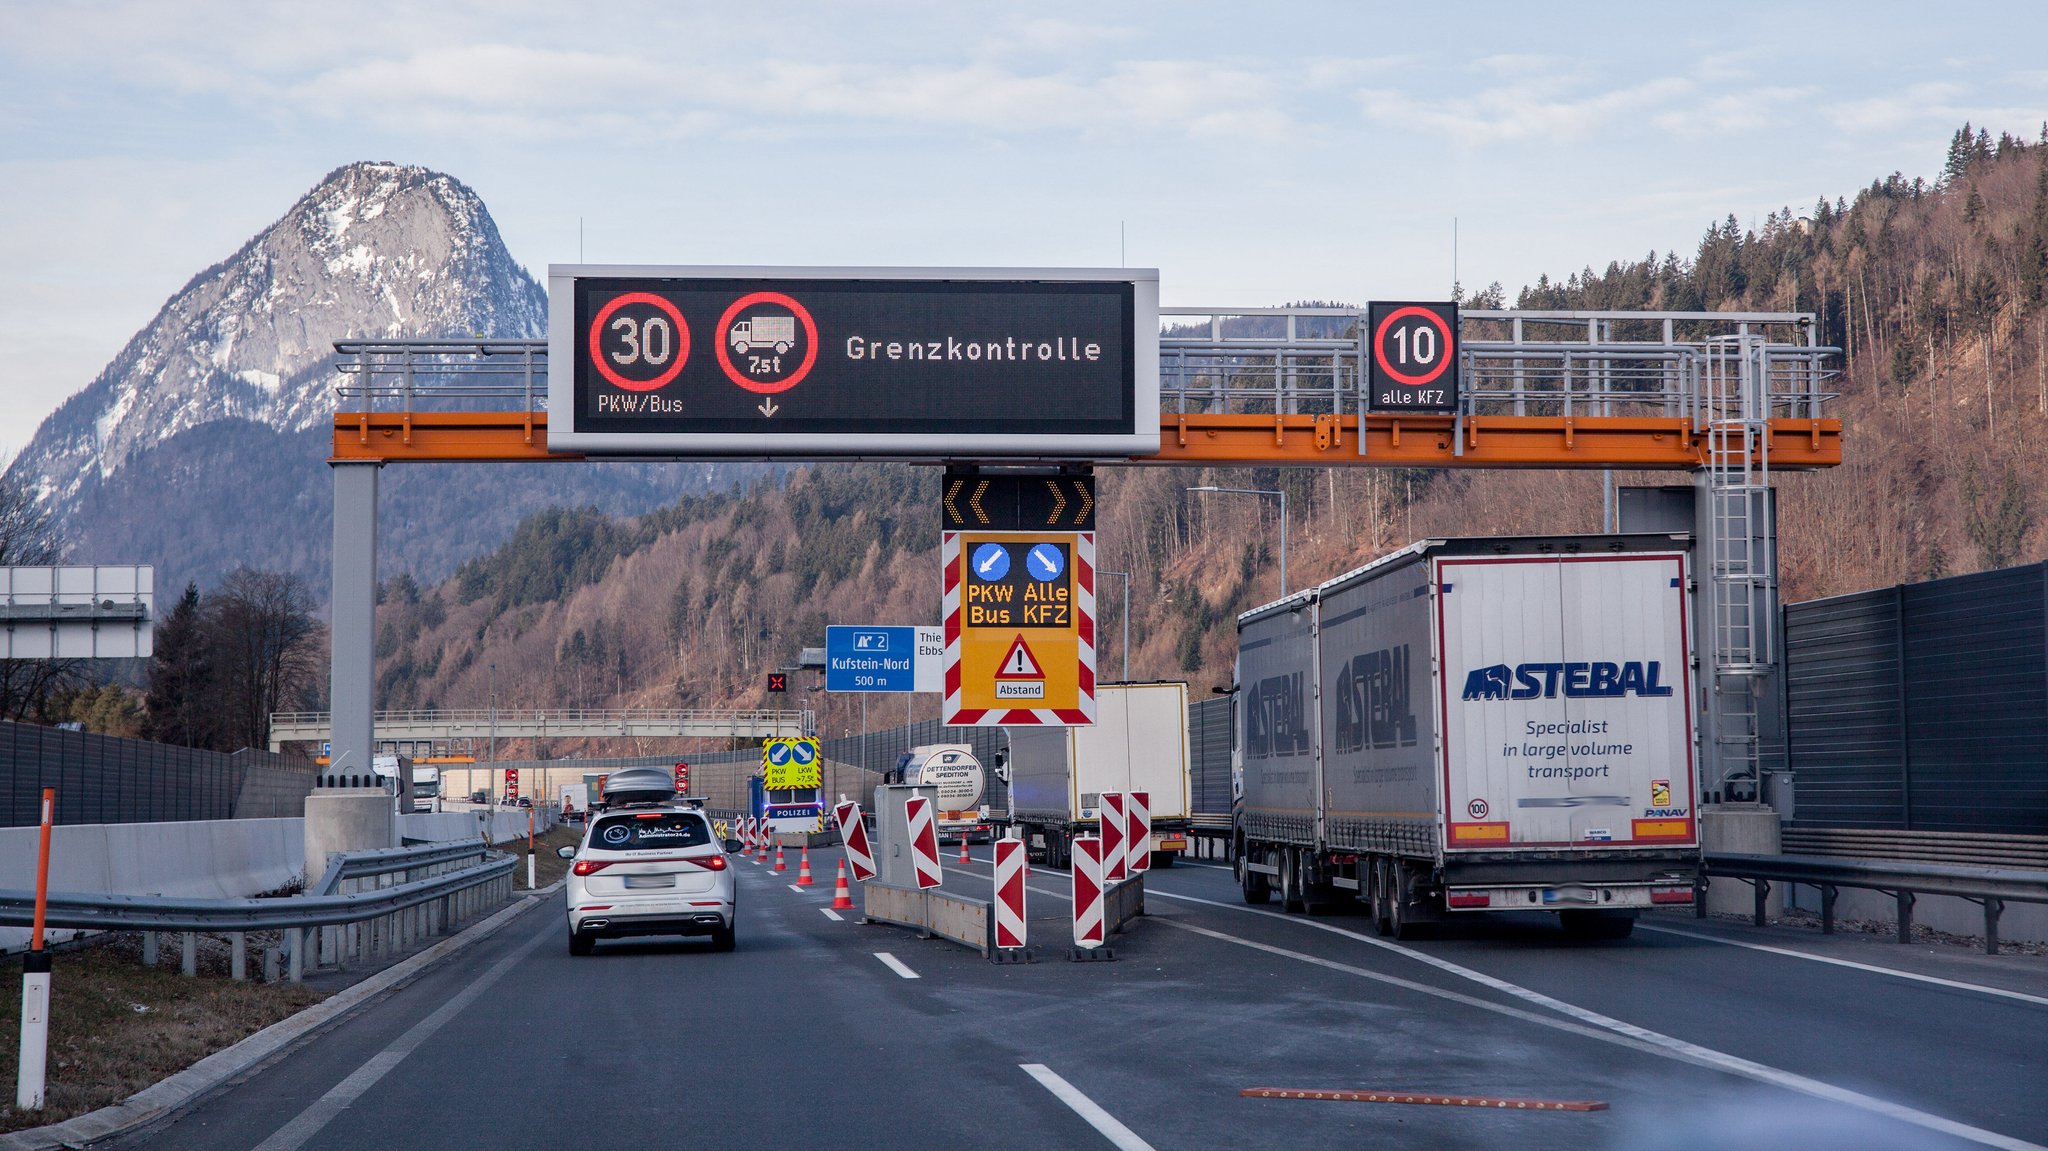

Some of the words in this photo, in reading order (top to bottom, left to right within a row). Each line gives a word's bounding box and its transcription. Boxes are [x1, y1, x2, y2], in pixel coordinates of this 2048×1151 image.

[611, 317, 670, 365] 30
[846, 336, 1101, 361] Grenzkontrolle
[1393, 326, 1435, 364] 10
[749, 355, 781, 374] 7,5t
[598, 395, 683, 413] PKW/Bus
[1382, 389, 1411, 404] alle
[1418, 390, 1444, 404] KFZ
[968, 584, 1013, 603] PKW
[1024, 583, 1069, 602] Alle
[971, 606, 1010, 624] Bus
[1024, 605, 1068, 624] KFZ
[877, 636, 885, 648] 2
[832, 657, 910, 670] Kufstein-Nord
[854, 676, 874, 686] 500
[876, 678, 887, 686] m
[999, 685, 1041, 695] Abstand
[1526, 720, 1608, 736] Specialist
[1503, 742, 1518, 756] in
[1523, 742, 1566, 759] large
[1570, 742, 1632, 756] volume
[927, 764, 977, 772] DETTENDORFER
[1528, 764, 1610, 780] transport
[777, 809, 810, 817] POLIZEI
[1471, 803, 1485, 814] 100
[1644, 809, 1688, 817] PANAV
